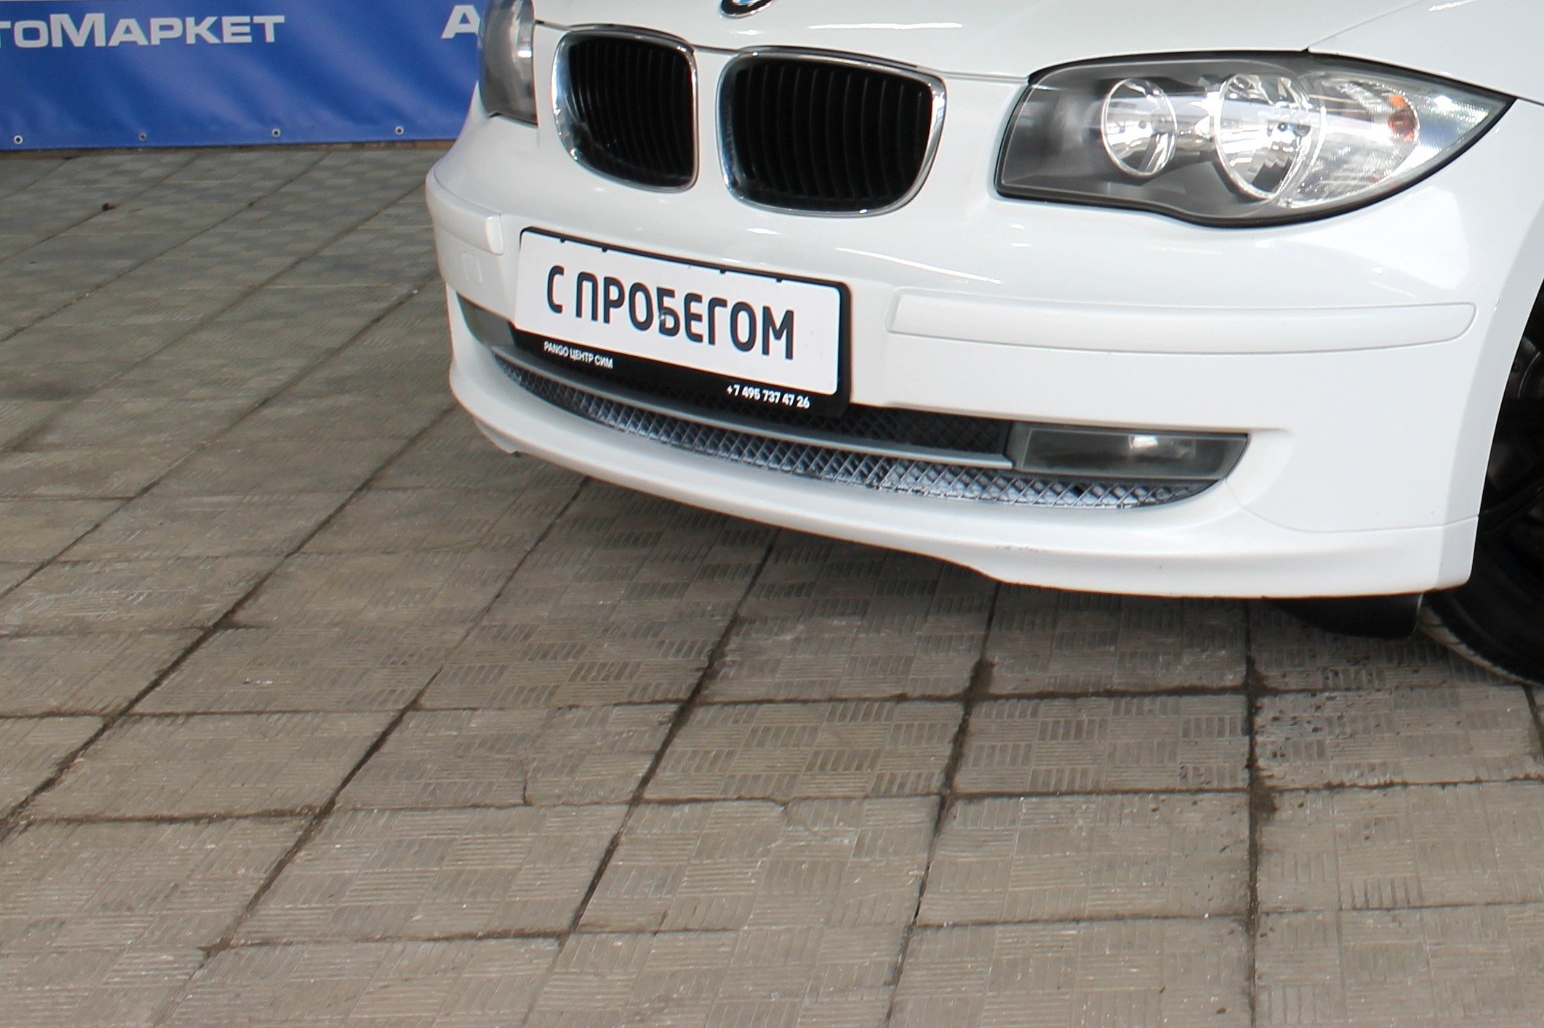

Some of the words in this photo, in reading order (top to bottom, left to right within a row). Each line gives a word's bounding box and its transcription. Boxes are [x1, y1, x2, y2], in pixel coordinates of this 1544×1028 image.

[547, 265, 565, 314] С
[576, 271, 795, 361] ПРОБЕГОМ
[569, 348, 594, 363] ЦЕНТР
[594, 355, 613, 369] СИМ
[727, 384, 740, 397] +7
[742, 386, 761, 400] 495
[762, 389, 780, 404] 737
[782, 393, 795, 406] 47
[796, 395, 810, 409] 26
